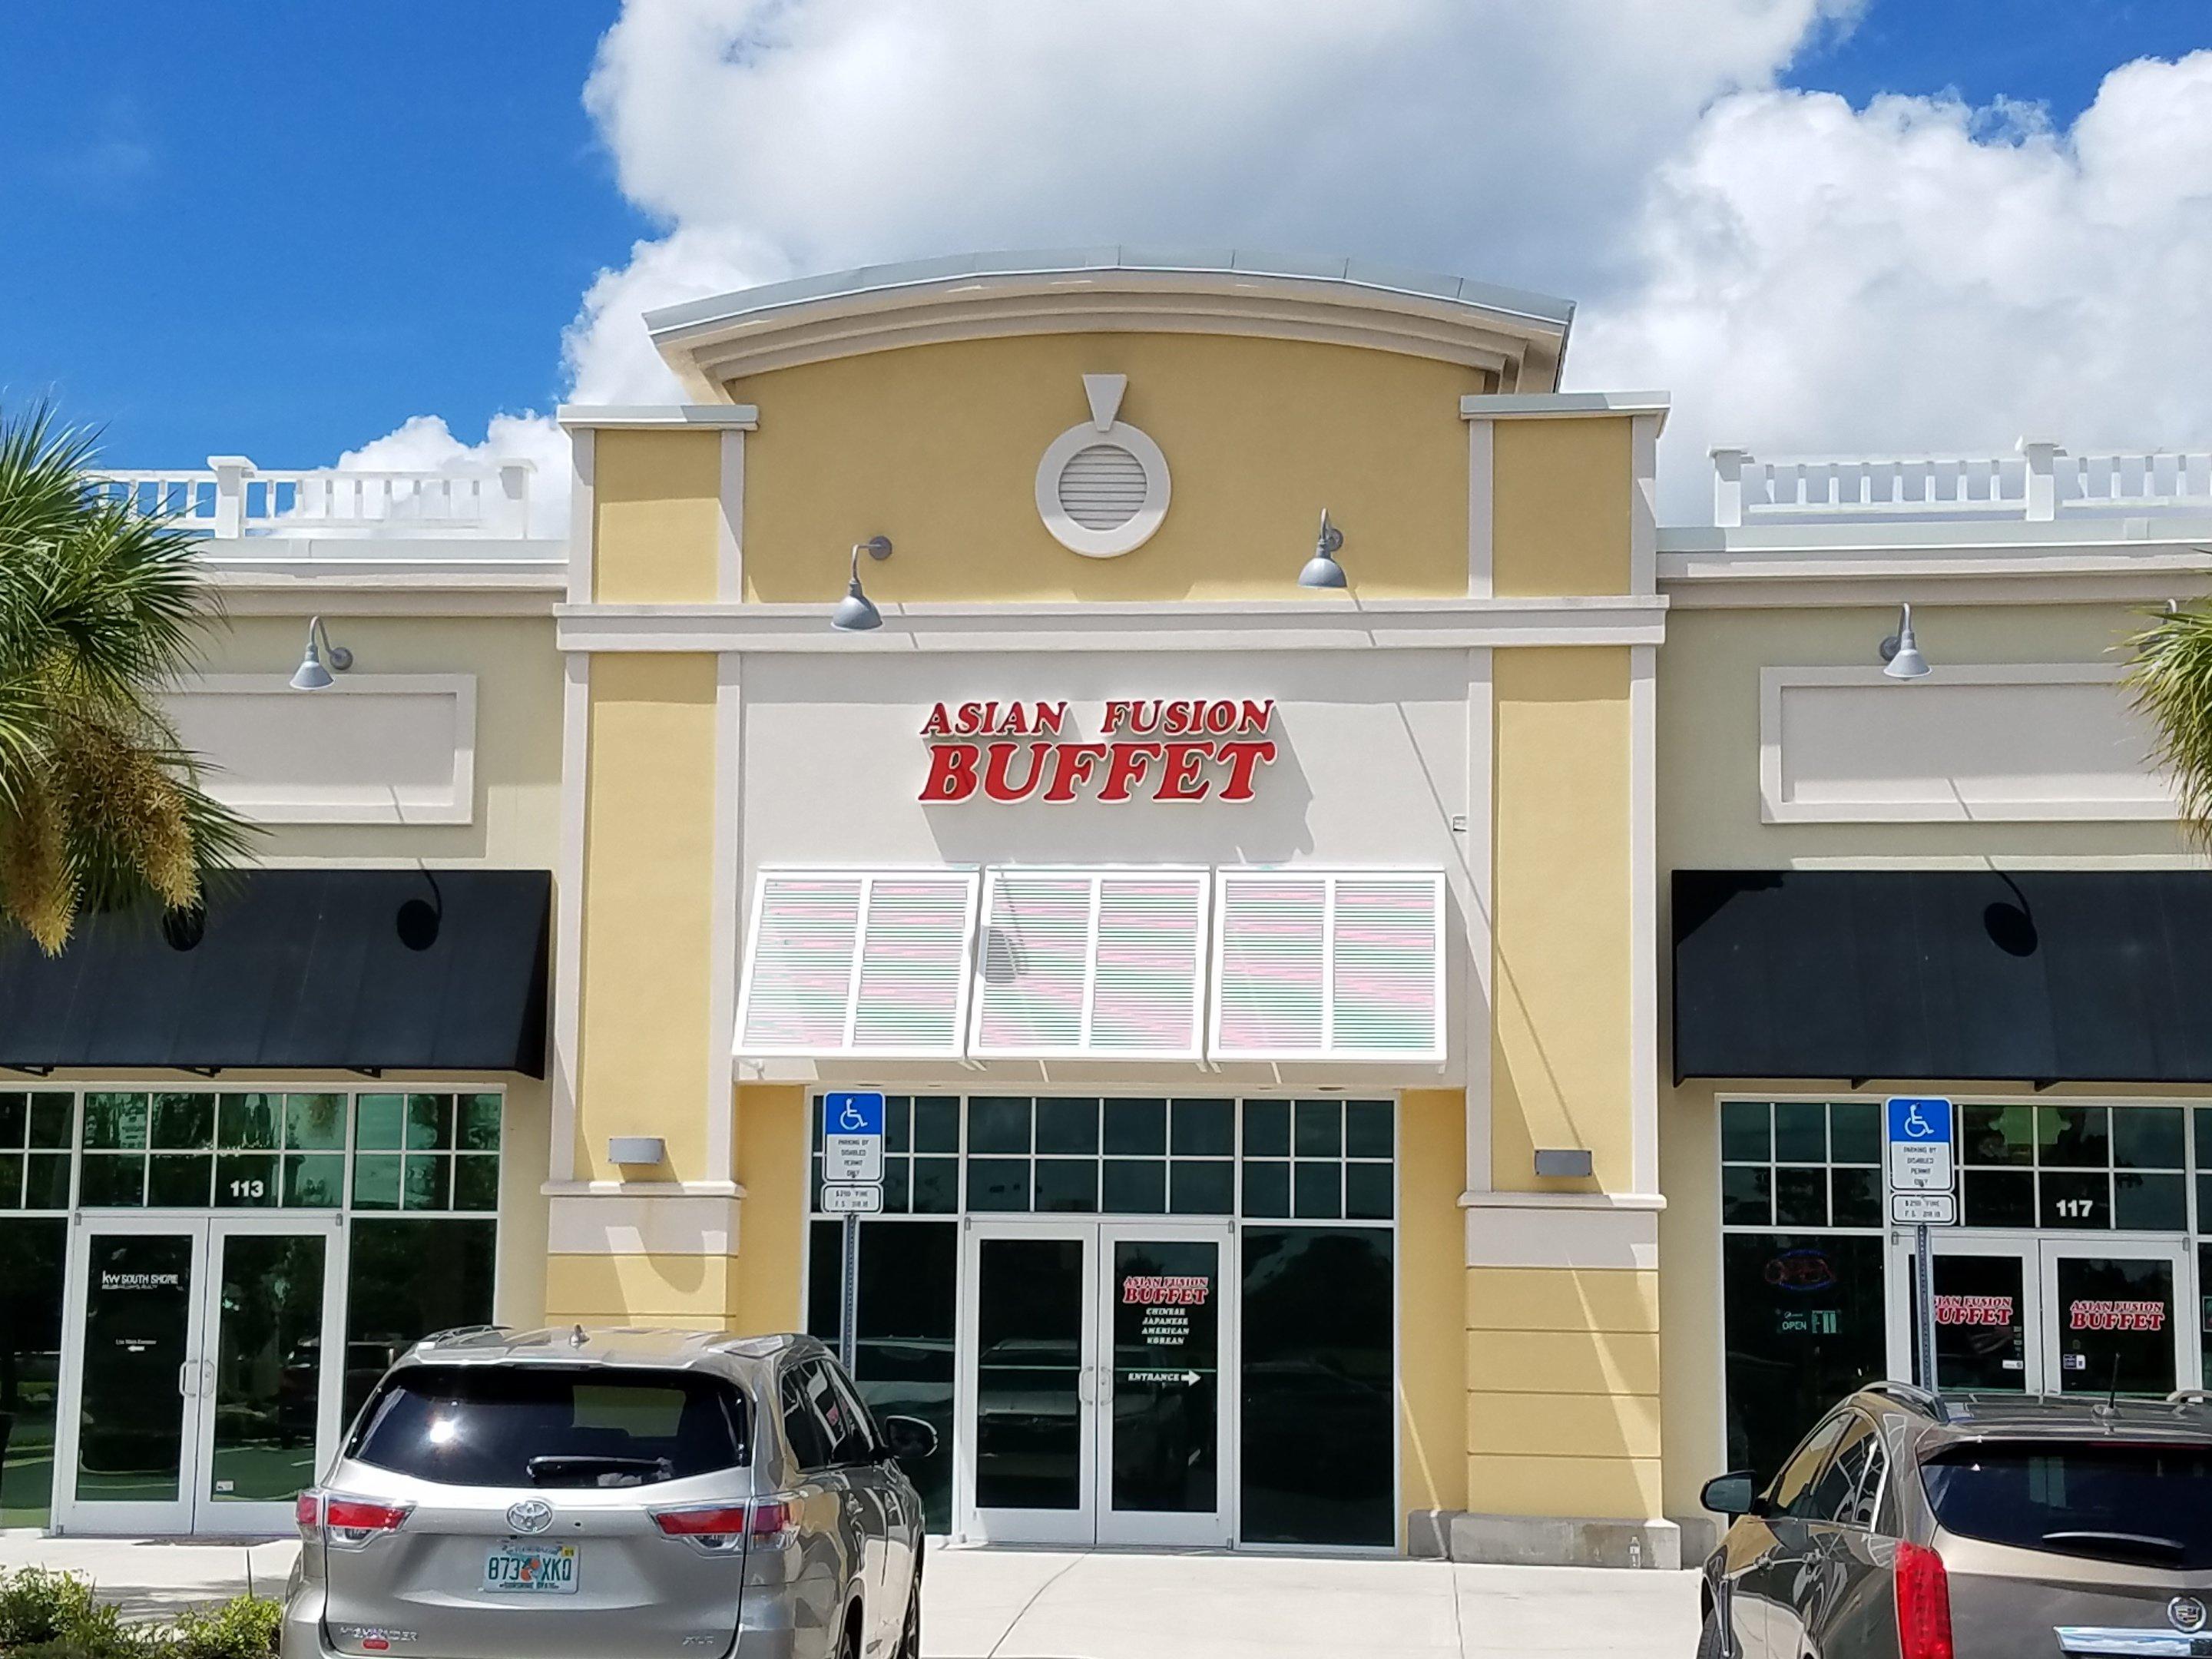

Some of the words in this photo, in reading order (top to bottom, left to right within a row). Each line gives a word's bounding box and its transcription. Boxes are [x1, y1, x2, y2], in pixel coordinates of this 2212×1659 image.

[920, 700, 1068, 736] ASIAN
[1099, 699, 1274, 735] FUSION
[919, 742, 1277, 804] BUFFET
[230, 1180, 264, 1197] 113
[2056, 1199, 2093, 1217] 117
[121, 1274, 149, 1284] SOUTH
[1124, 1277, 1162, 1287] ASIAN
[1163, 1277, 1209, 1287] FUSION
[1123, 1286, 1209, 1304] BUFFET
[1934, 1295, 1961, 1307] IAN
[1963, 1296, 2012, 1308] FUSION
[1146, 1307, 1186, 1316] CHINESE
[2070, 1300, 2111, 1312] ASIAN
[2113, 1301, 2164, 1313] FUSION
[1934, 1306, 2014, 1325] UFFET
[2070, 1312, 2165, 1330] BUFFET
[1782, 1321, 1807, 1330] OPEN
[1147, 1336, 1185, 1345] KOREAN
[1128, 1373, 1180, 1382] ENTRANCE
[488, 1556, 520, 1580] 873
